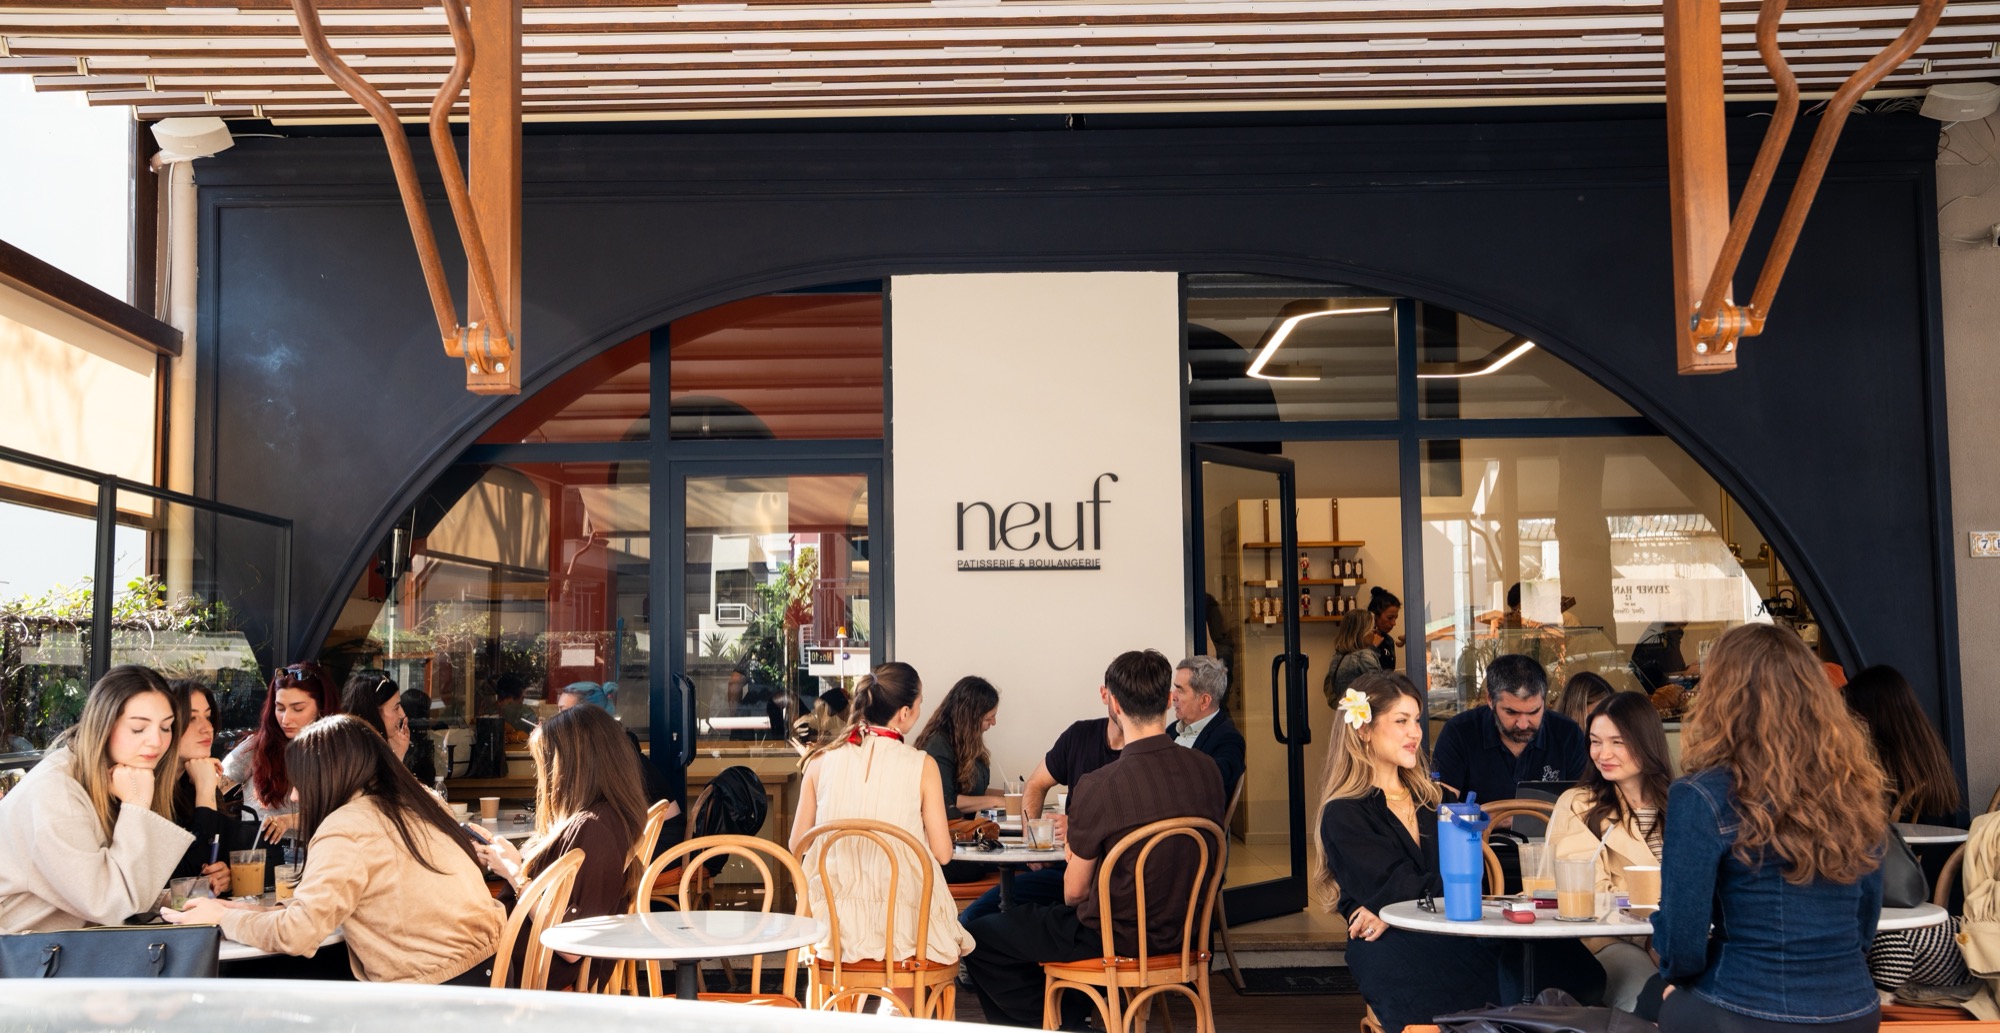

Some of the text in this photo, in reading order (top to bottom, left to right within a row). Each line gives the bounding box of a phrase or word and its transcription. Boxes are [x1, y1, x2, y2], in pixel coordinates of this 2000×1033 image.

[957, 472, 1119, 551] neuf
[957, 558, 1101, 569] PATISSERIE & BOULANGERIE
